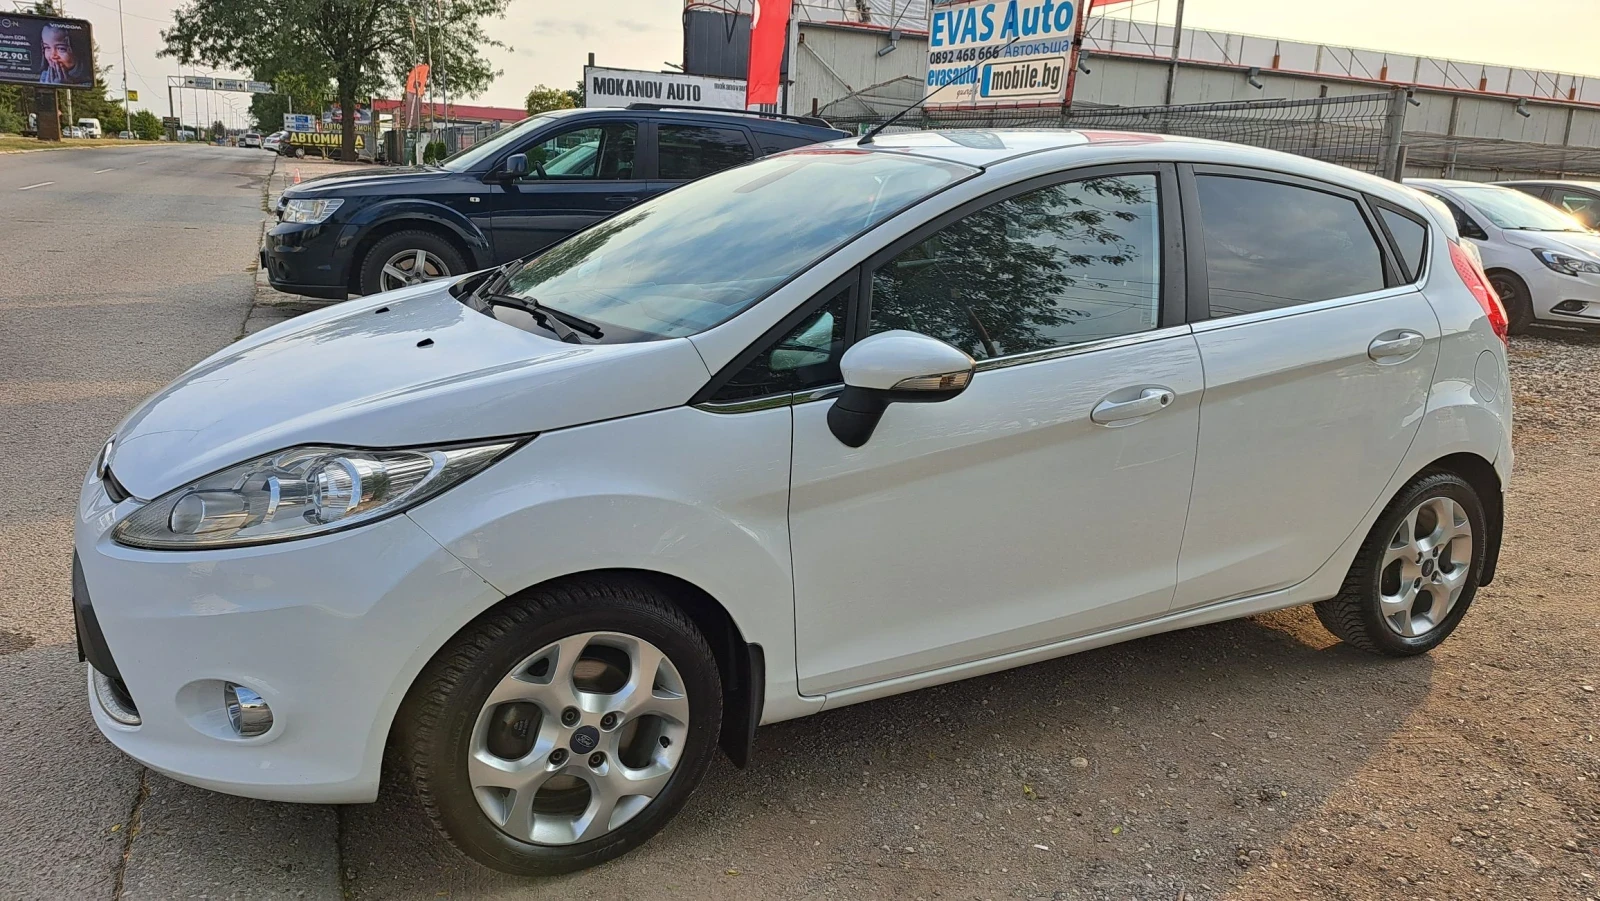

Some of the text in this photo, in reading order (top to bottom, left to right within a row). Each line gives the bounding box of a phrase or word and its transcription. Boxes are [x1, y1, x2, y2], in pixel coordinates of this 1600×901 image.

[49, 22, 82, 30] VIVACOM
[931, 0, 1073, 47] EVAS Auto
[930, 39, 1070, 65] 0892 468 666 Автокъща
[593, 76, 701, 102] MOKANOV AUTO
[991, 62, 1061, 91] mobile.bg
[290, 132, 364, 146] АВТОМИА
